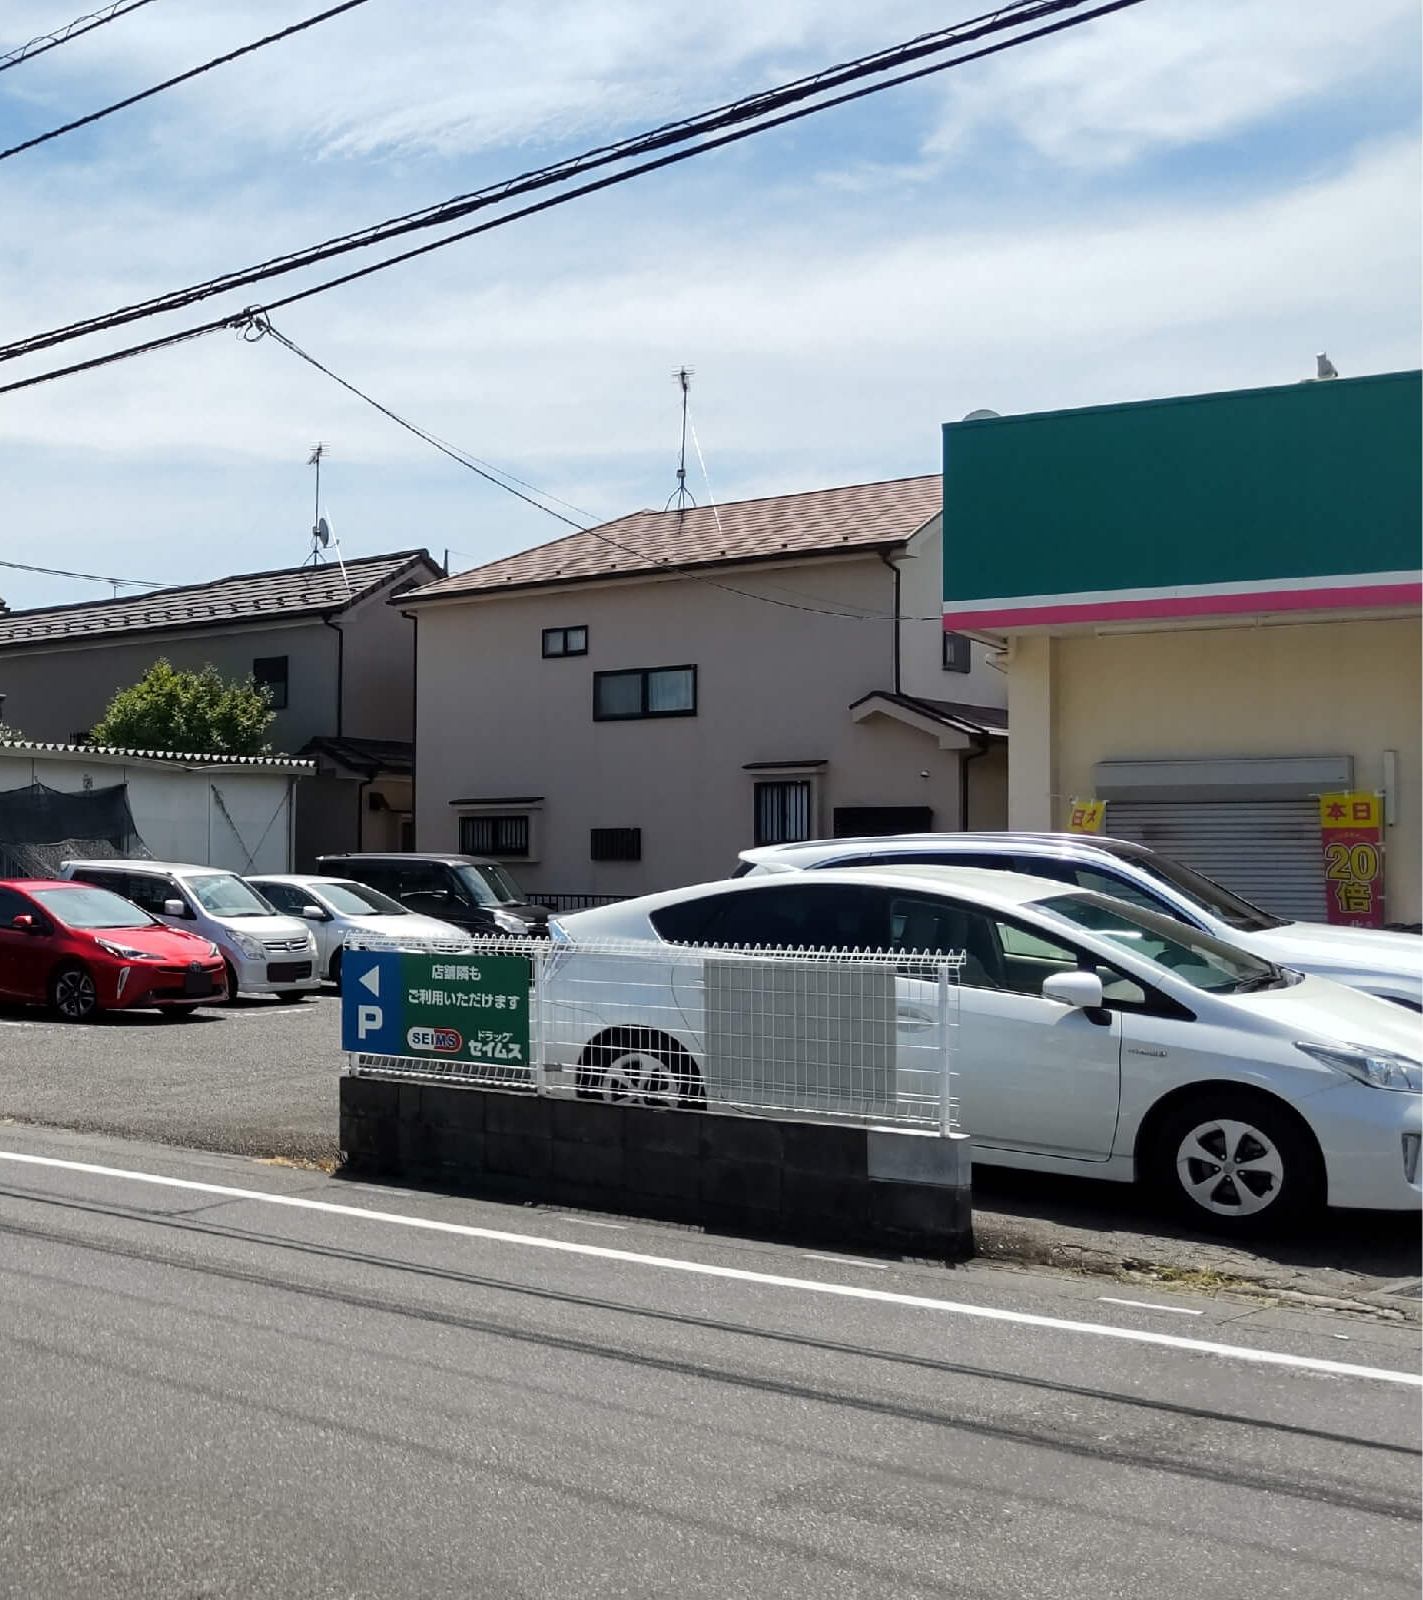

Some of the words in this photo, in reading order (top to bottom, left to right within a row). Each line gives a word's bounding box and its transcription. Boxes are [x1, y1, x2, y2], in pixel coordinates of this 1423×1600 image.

[1325, 802, 1371, 821] 本日
[1324, 843, 1378, 881] 20
[1336, 881, 1372, 913] 倍
[431, 964, 482, 981] 店舗隣も
[408, 989, 521, 1010] ご利用いただけます
[358, 1004, 383, 1040] P
[411, 1032, 457, 1048] SEIMS
[477, 1030, 514, 1043] ドラッグ
[468, 1039, 523, 1060] セイムス
